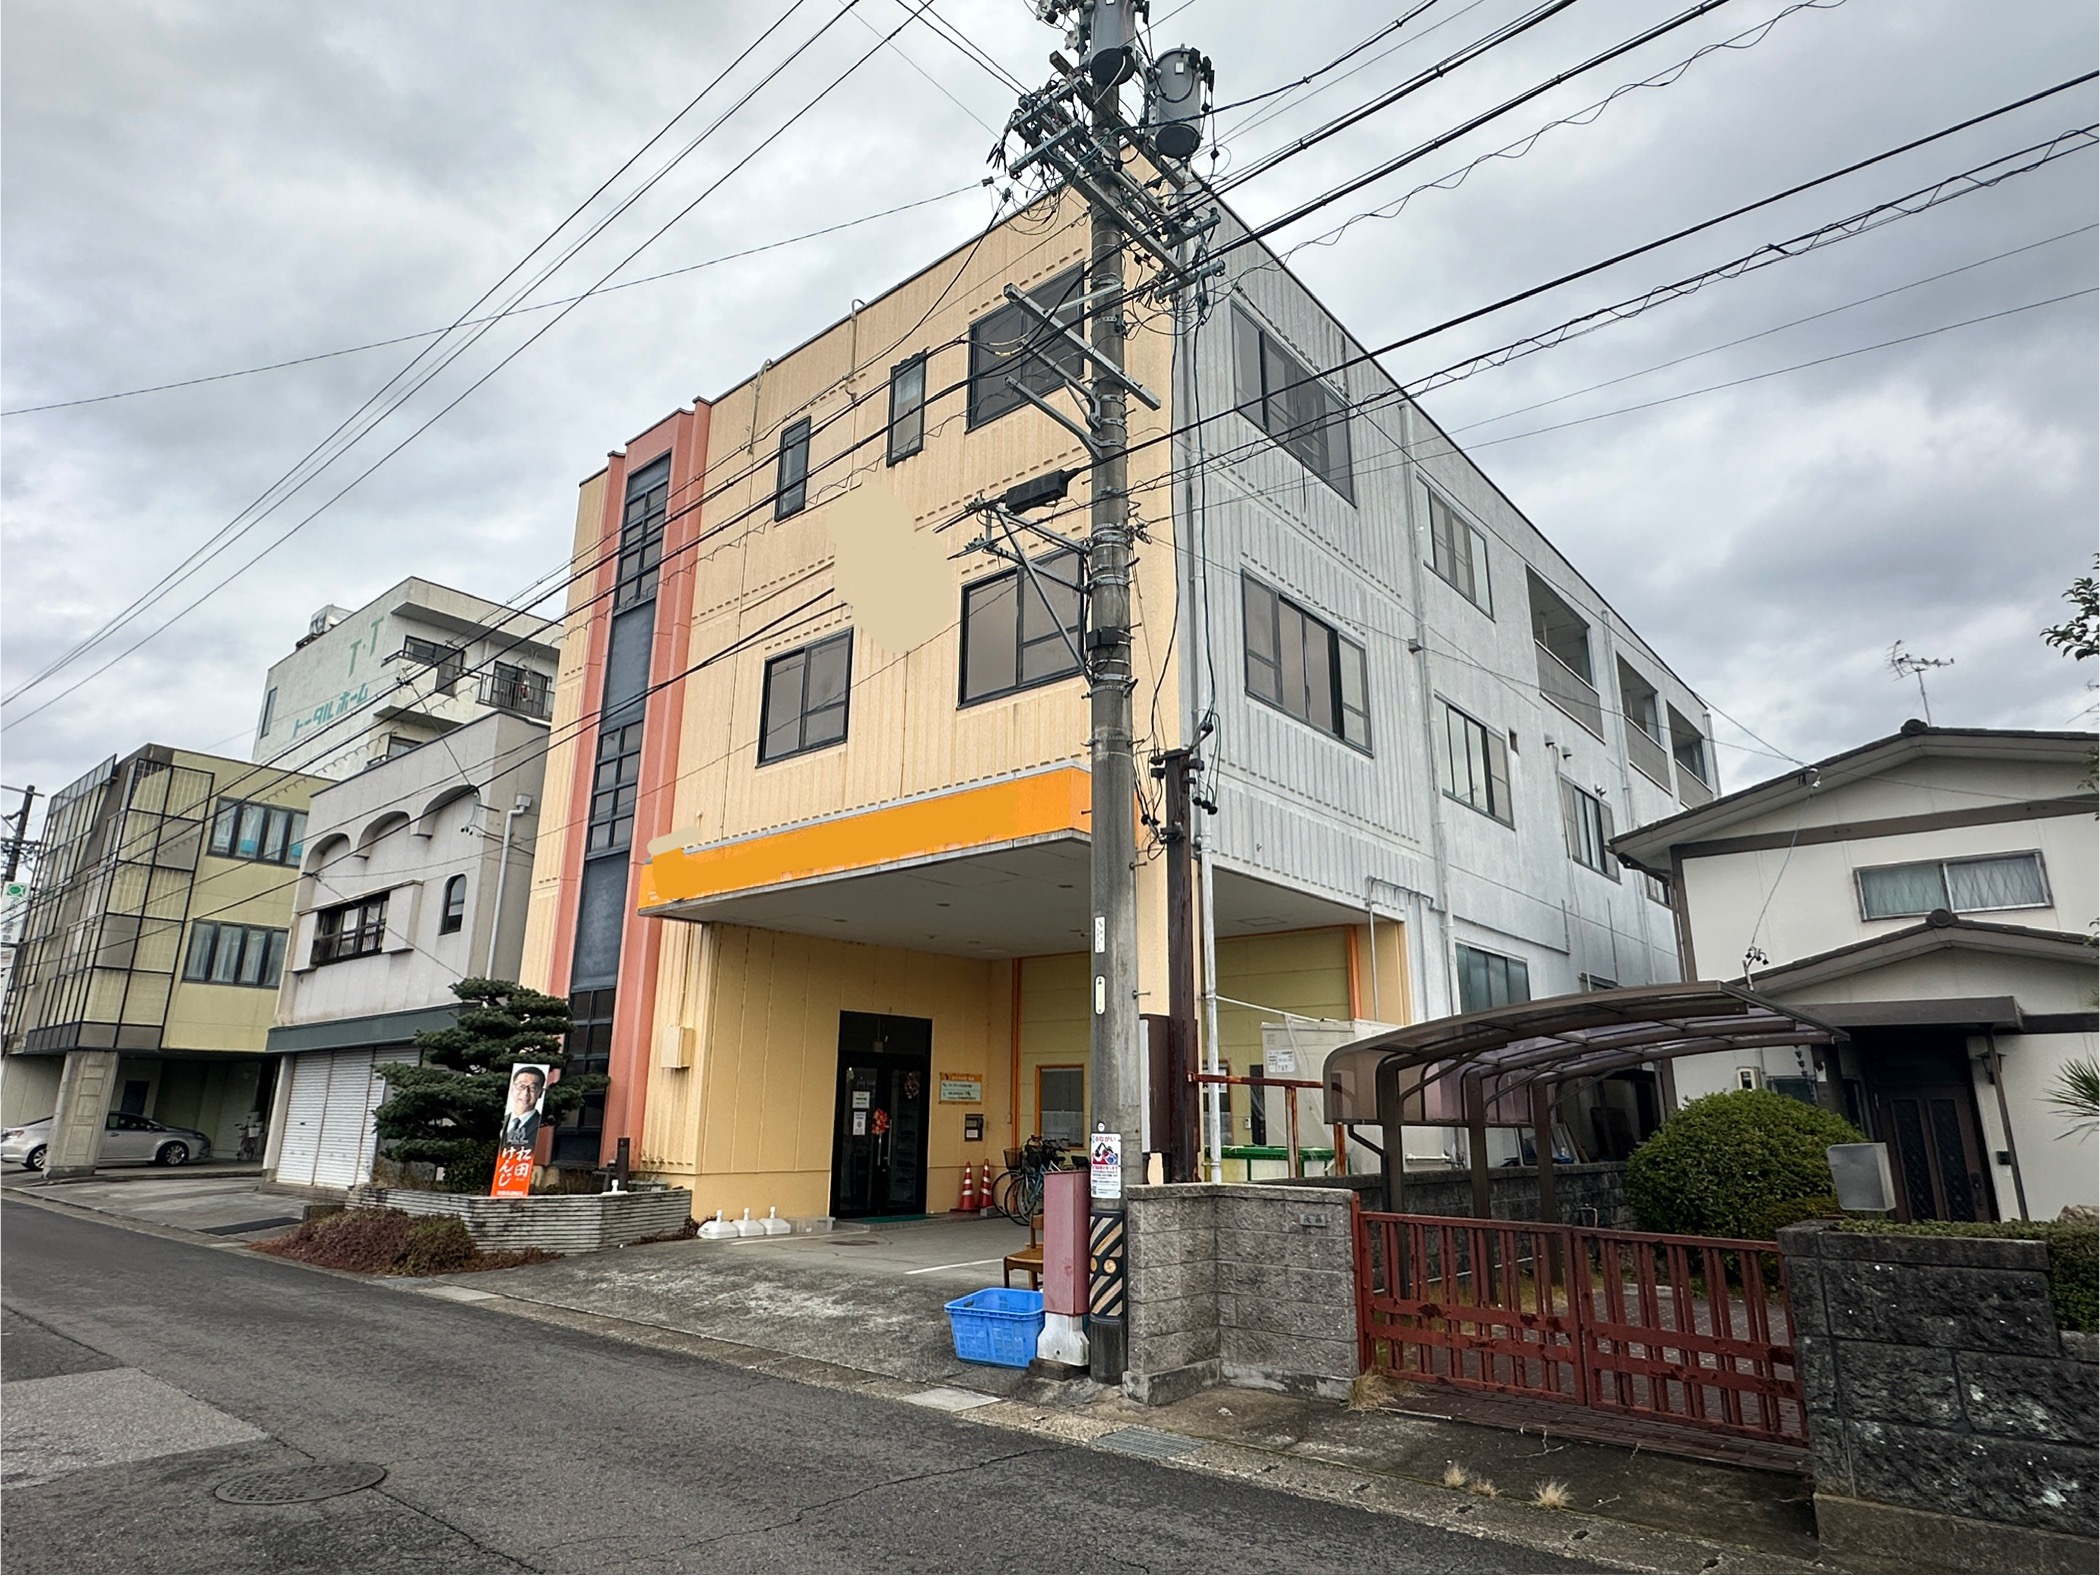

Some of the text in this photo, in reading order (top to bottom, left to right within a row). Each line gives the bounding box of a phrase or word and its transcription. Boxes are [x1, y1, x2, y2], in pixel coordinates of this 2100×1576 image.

[292, 683, 369, 738] トータルホーム
[498, 1146, 517, 1187] けんじ
